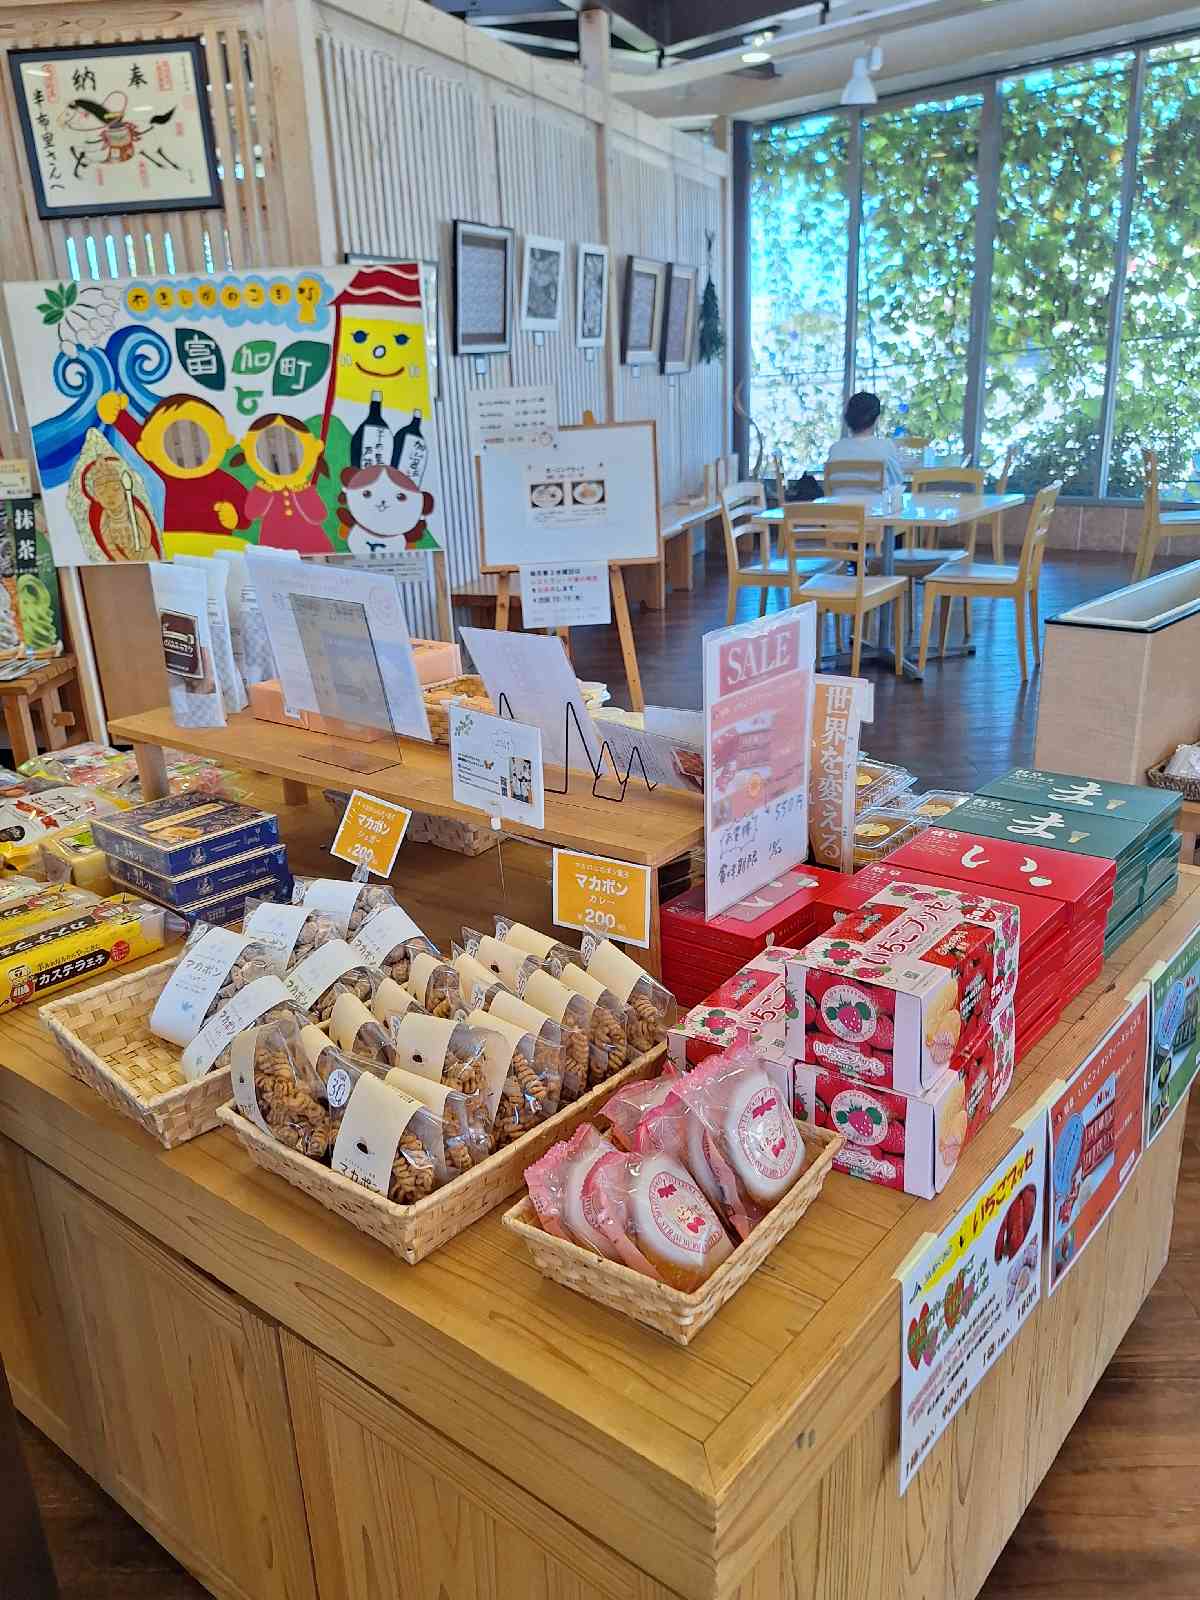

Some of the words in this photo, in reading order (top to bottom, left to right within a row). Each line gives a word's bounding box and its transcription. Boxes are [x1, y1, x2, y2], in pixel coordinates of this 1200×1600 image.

[15, 508, 36, 560] 抹茶
[726, 630, 793, 686] SALE
[813, 685, 851, 858] 世界を変える
[575, 873, 629, 896] マカポン
